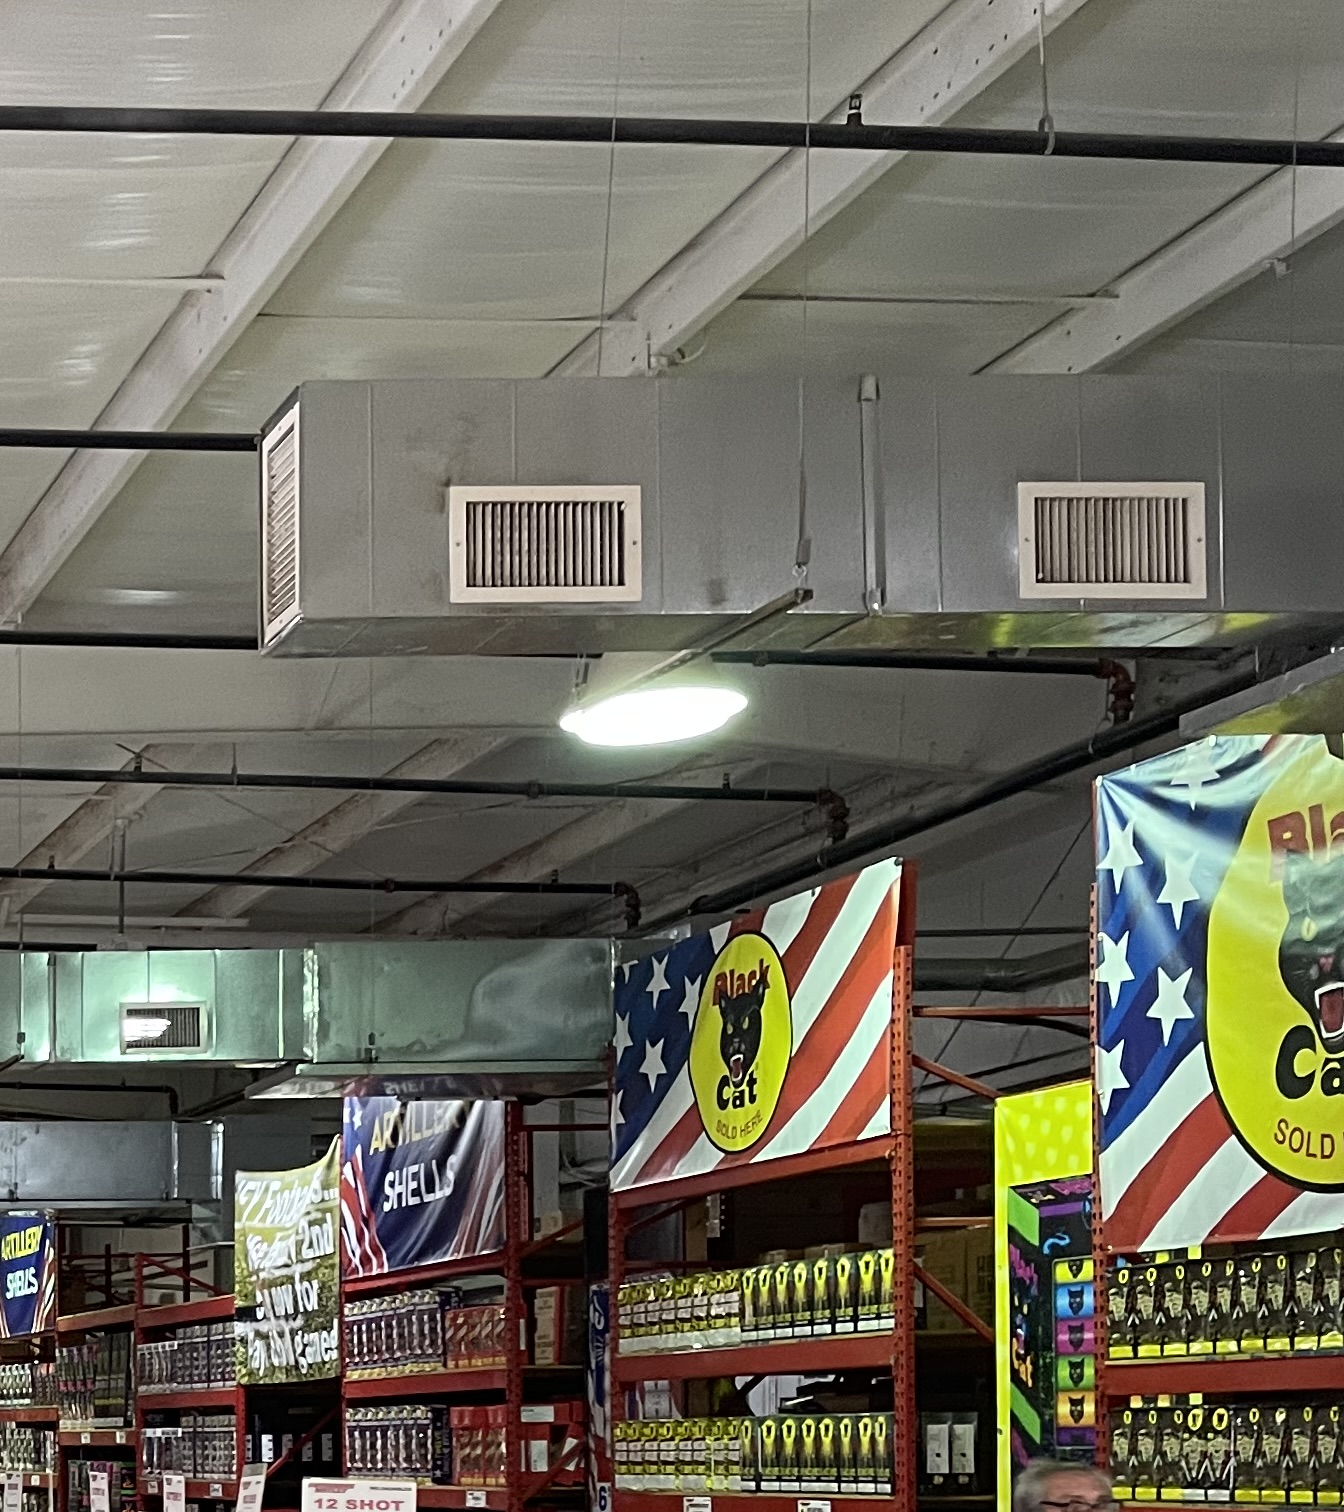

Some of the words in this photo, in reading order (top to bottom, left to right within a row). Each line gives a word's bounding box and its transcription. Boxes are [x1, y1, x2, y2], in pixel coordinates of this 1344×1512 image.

[712, 959, 770, 1007] Black
[716, 1070, 757, 1111] Cat
[715, 1118, 738, 1140] SOLD
[739, 1111, 764, 1138] HERE
[1273, 1117, 1335, 1160] SOLD
[383, 1154, 459, 1213] SHELLS
[314, 1499, 338, 1510] 12
[345, 1499, 405, 1512] SHOT
